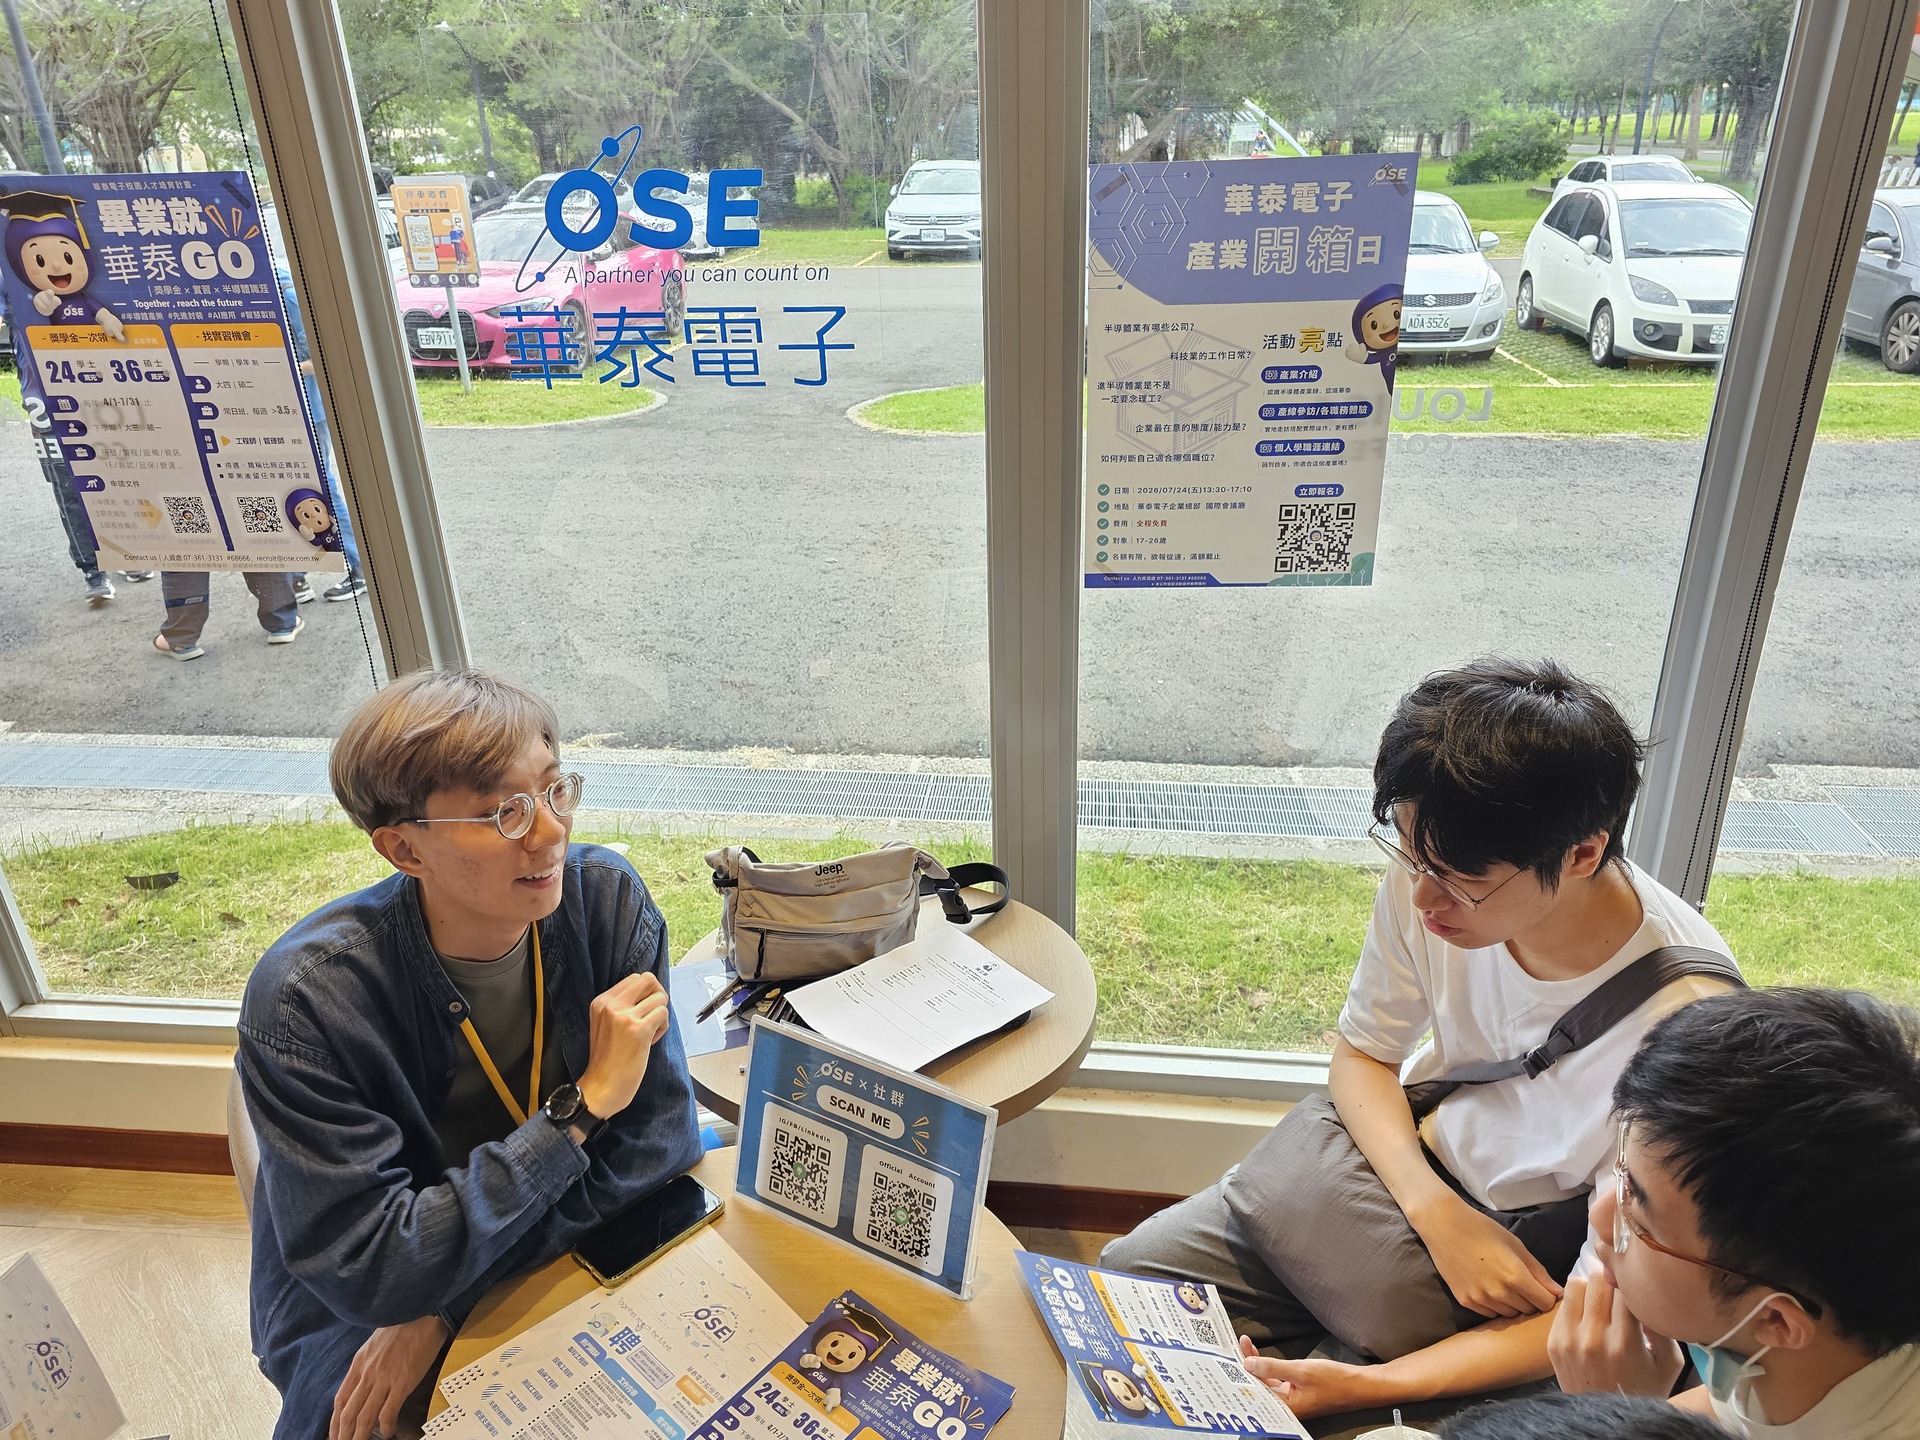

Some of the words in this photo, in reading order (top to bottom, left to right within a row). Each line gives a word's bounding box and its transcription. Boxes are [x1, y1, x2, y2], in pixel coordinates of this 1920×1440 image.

[538, 160, 763, 256] OSE
[1224, 181, 1354, 215] 華泰電子
[96, 197, 207, 237] 畢業就
[100, 240, 255, 284] 華泰GO
[1186, 225, 1384, 276] 產業開箱日
[565, 266, 581, 283] A
[584, 266, 654, 286] partner
[660, 269, 696, 287] you
[702, 268, 731, 283] can
[736, 265, 800, 282] count
[806, 266, 829, 281] on
[133, 299, 170, 310] Together
[201, 299, 215, 307] the
[217, 299, 243, 307] future
[203, 331, 251, 341] 找實習機會
[1408, 317, 1450, 329] ADA-3526
[500, 306, 855, 389] 華泰電子
[1263, 327, 1343, 353] 活動亮點
[45, 361, 76, 383] 24
[110, 360, 143, 382] 36
[1136, 520, 1168, 528] 全程免費
[818, 1061, 855, 1086] OSE
[829, 1095, 866, 1118] SCAN
[871, 1112, 891, 1129] ME
[879, 1160, 903, 1174] Official
[909, 1173, 936, 1189] Account
[690, 1307, 732, 1340] OSE
[608, 1326, 642, 1355] 聘
[36, 1341, 67, 1384] OSE
[811, 1371, 828, 1384] OSE
[890, 1347, 964, 1406] 畢業就
[754, 1382, 781, 1405] 24
[793, 1412, 821, 1437] 36
